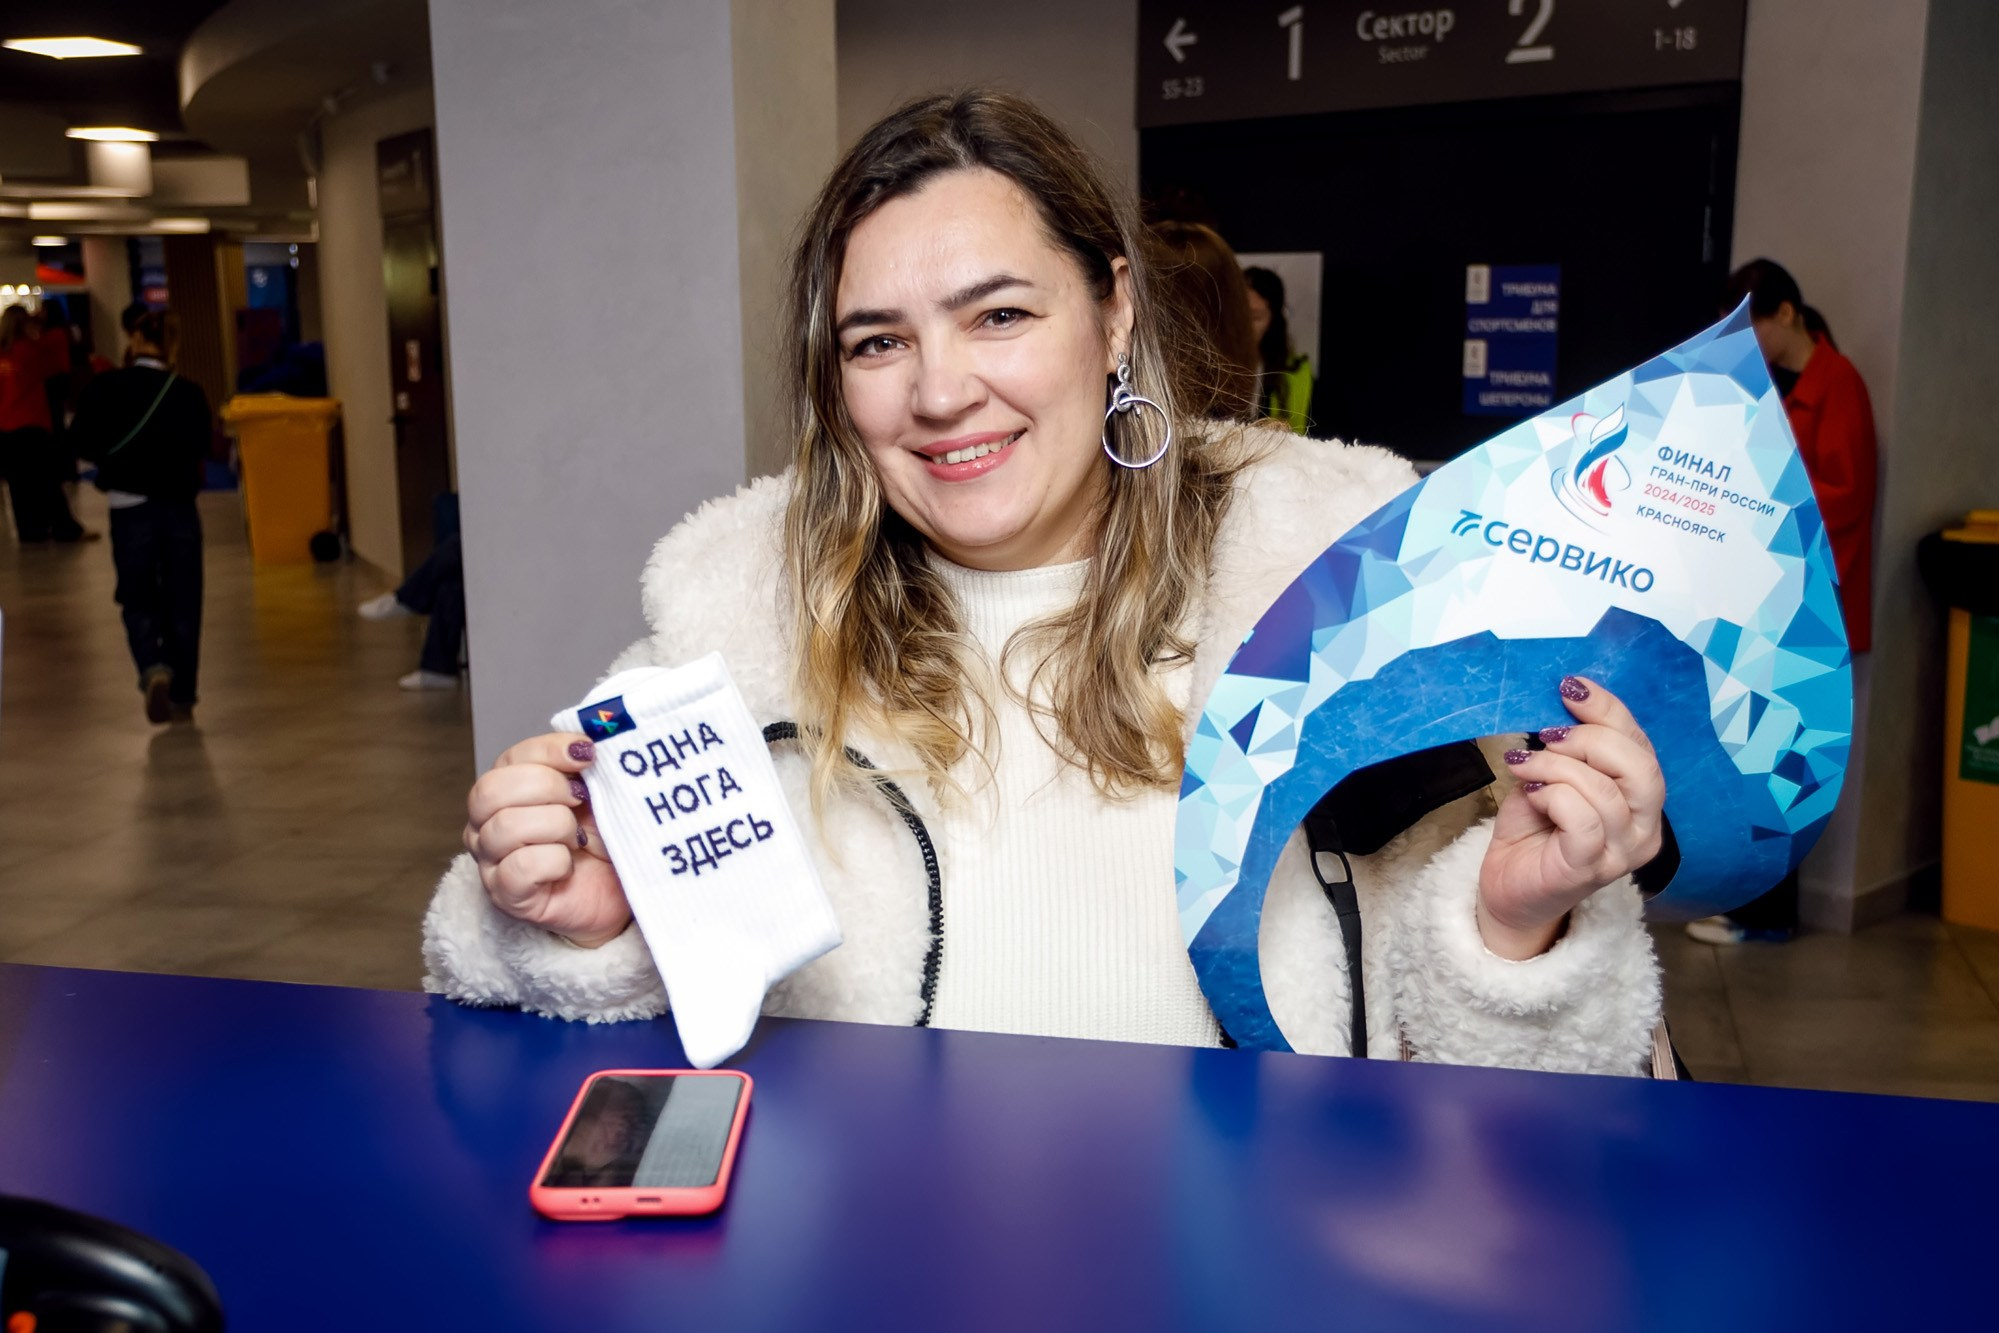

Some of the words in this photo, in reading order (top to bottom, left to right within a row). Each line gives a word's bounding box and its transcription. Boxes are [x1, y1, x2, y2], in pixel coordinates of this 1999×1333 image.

[1279, 6, 1304, 80] 1
[1356, 9, 1455, 43] Сектор
[1505, 0, 1555, 64] 2
[1654, 26, 1698, 51] 1-18
[1378, 43, 1428, 64] Sector
[1502, 282, 1557, 298] ТРИБУНА
[1531, 300, 1558, 316] ДЛЯ
[1467, 317, 1557, 333] СПОРТСМЕНОВ
[1489, 370, 1550, 387] ТРИБУНА
[1657, 444, 1732, 483] ФИНАЛ
[1643, 483, 1716, 516] 2024/2025
[1650, 466, 1719, 499] ГРАН-ПРИ
[1721, 488, 1777, 518] РОССИИ
[1636, 504, 1727, 543] КРАСНОЯРСК
[1483, 520, 1655, 594] сервико
[619, 722, 724, 778] ОДНА
[644, 766, 742, 825] НОГА
[661, 813, 775, 877] ЗДЕСЬ
